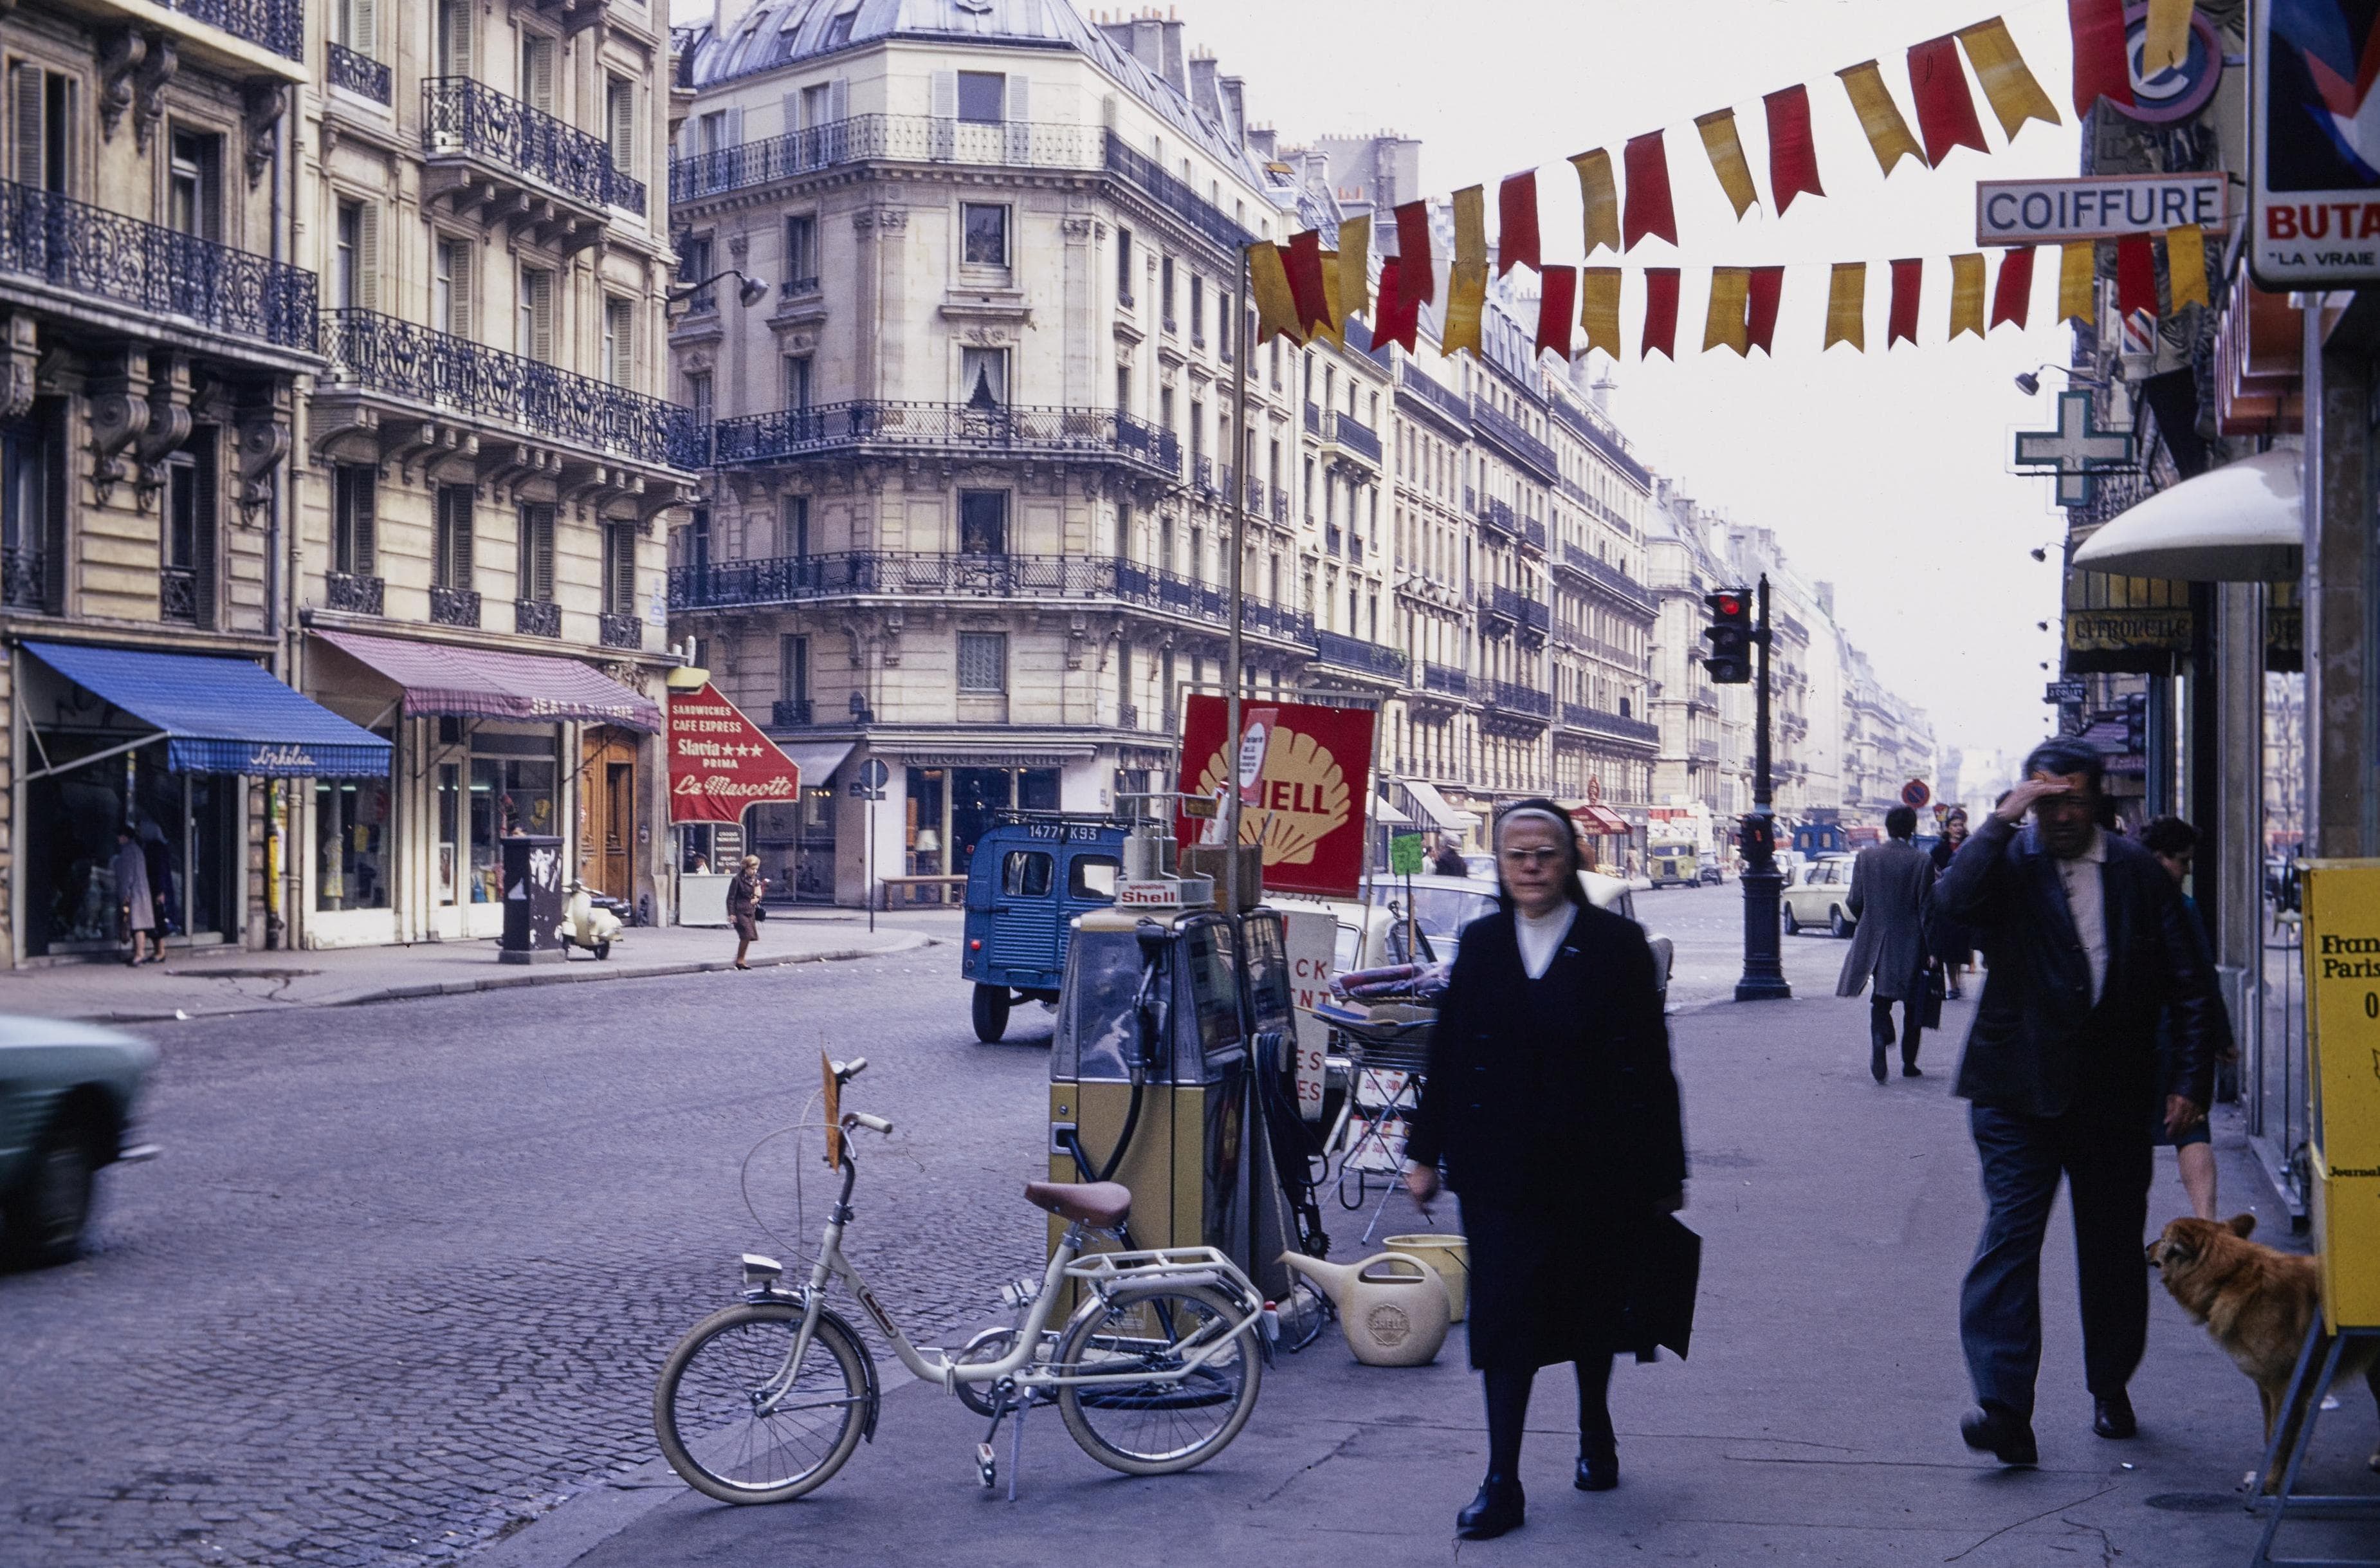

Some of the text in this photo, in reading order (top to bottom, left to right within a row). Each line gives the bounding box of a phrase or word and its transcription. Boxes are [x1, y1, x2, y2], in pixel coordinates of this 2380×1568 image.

[1987, 186, 2217, 230] COIFFURE
[2314, 252, 2375, 266] VRAIE
[673, 705, 731, 716] SANDWICHES
[673, 720, 742, 733] CAFE EXPRESS
[678, 738, 720, 757] Slavia
[702, 759, 738, 769] PRIMA
[704, 775, 792, 797] Mascotte
[1259, 780, 1330, 815] ELL
[1030, 825, 1097, 840] 1477 K93
[1121, 891, 1175, 903] Shell
